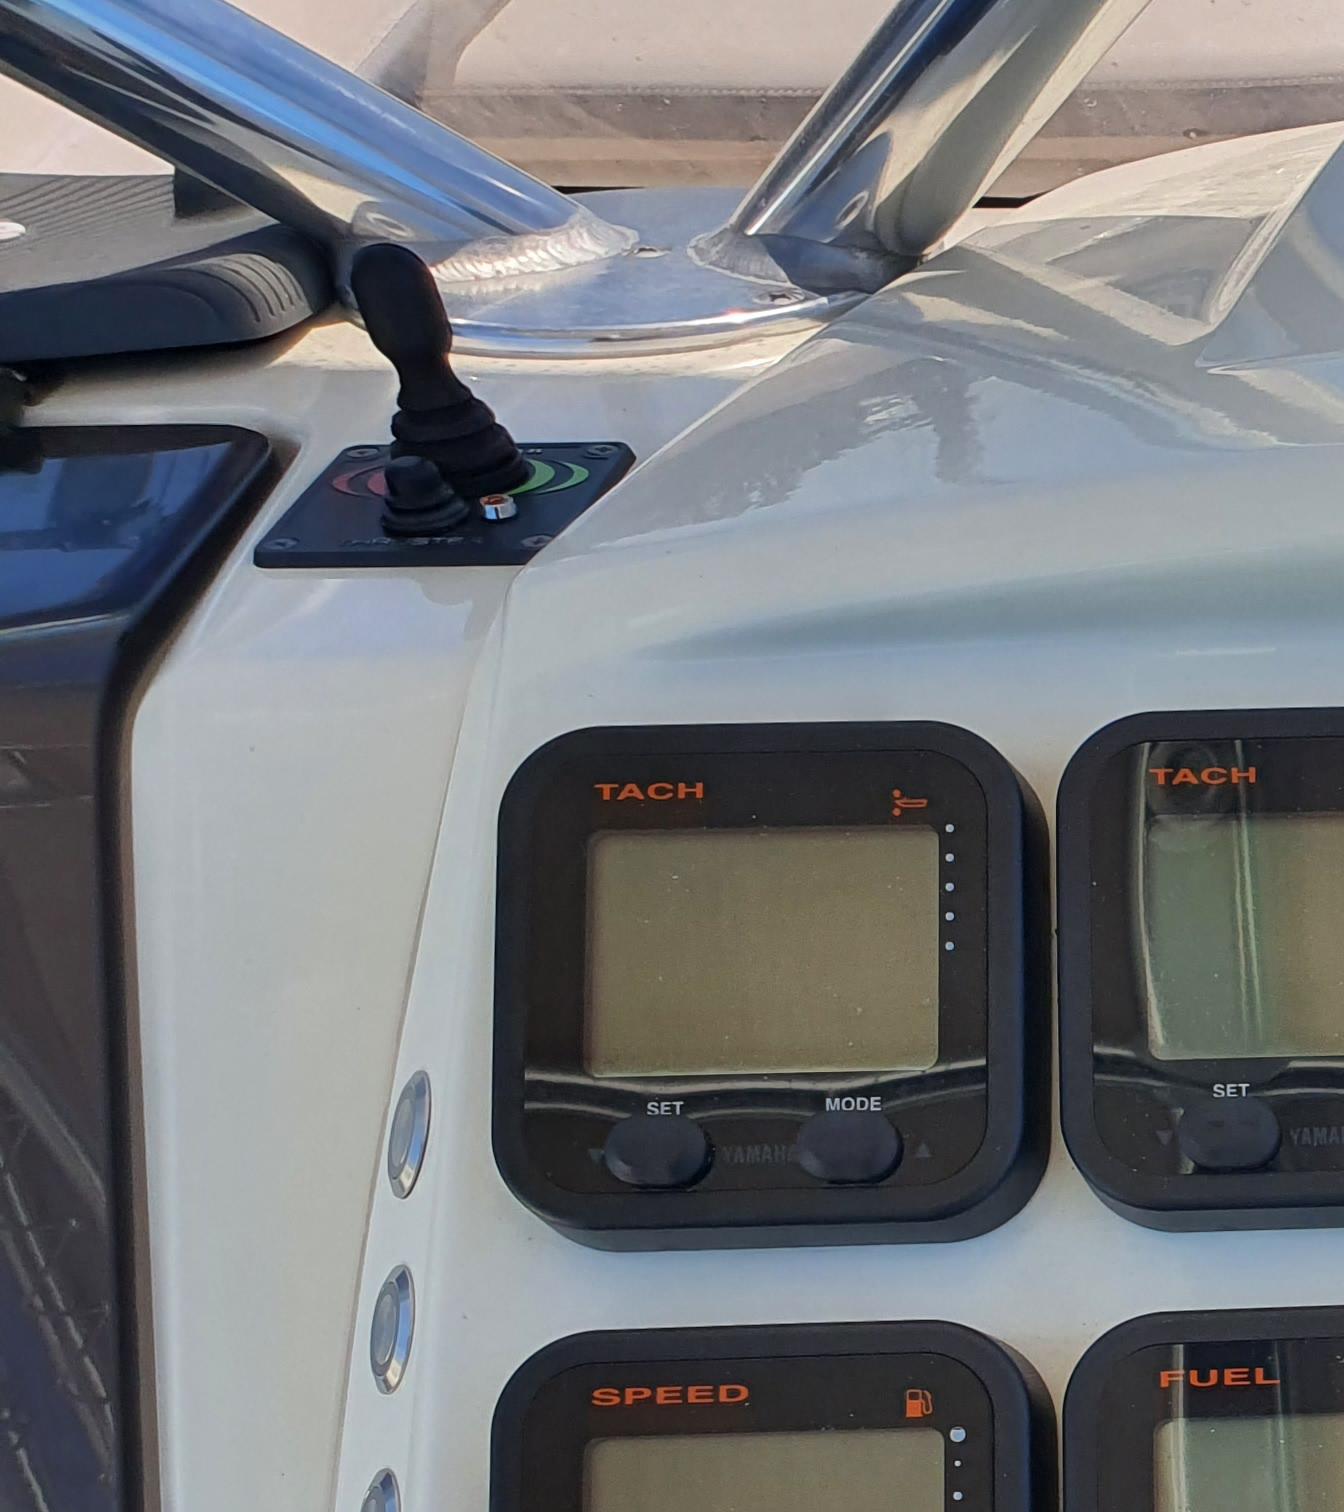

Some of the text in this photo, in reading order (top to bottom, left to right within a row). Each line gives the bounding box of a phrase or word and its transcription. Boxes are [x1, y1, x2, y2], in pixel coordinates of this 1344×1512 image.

[1149, 767, 1256, 786] TACH
[594, 782, 704, 801] TACH
[1212, 1083, 1250, 1098] SET
[647, 1096, 882, 1116] SET MODE
[1159, 1367, 1281, 1388] FUEL
[591, 1383, 750, 1407] SPEED
